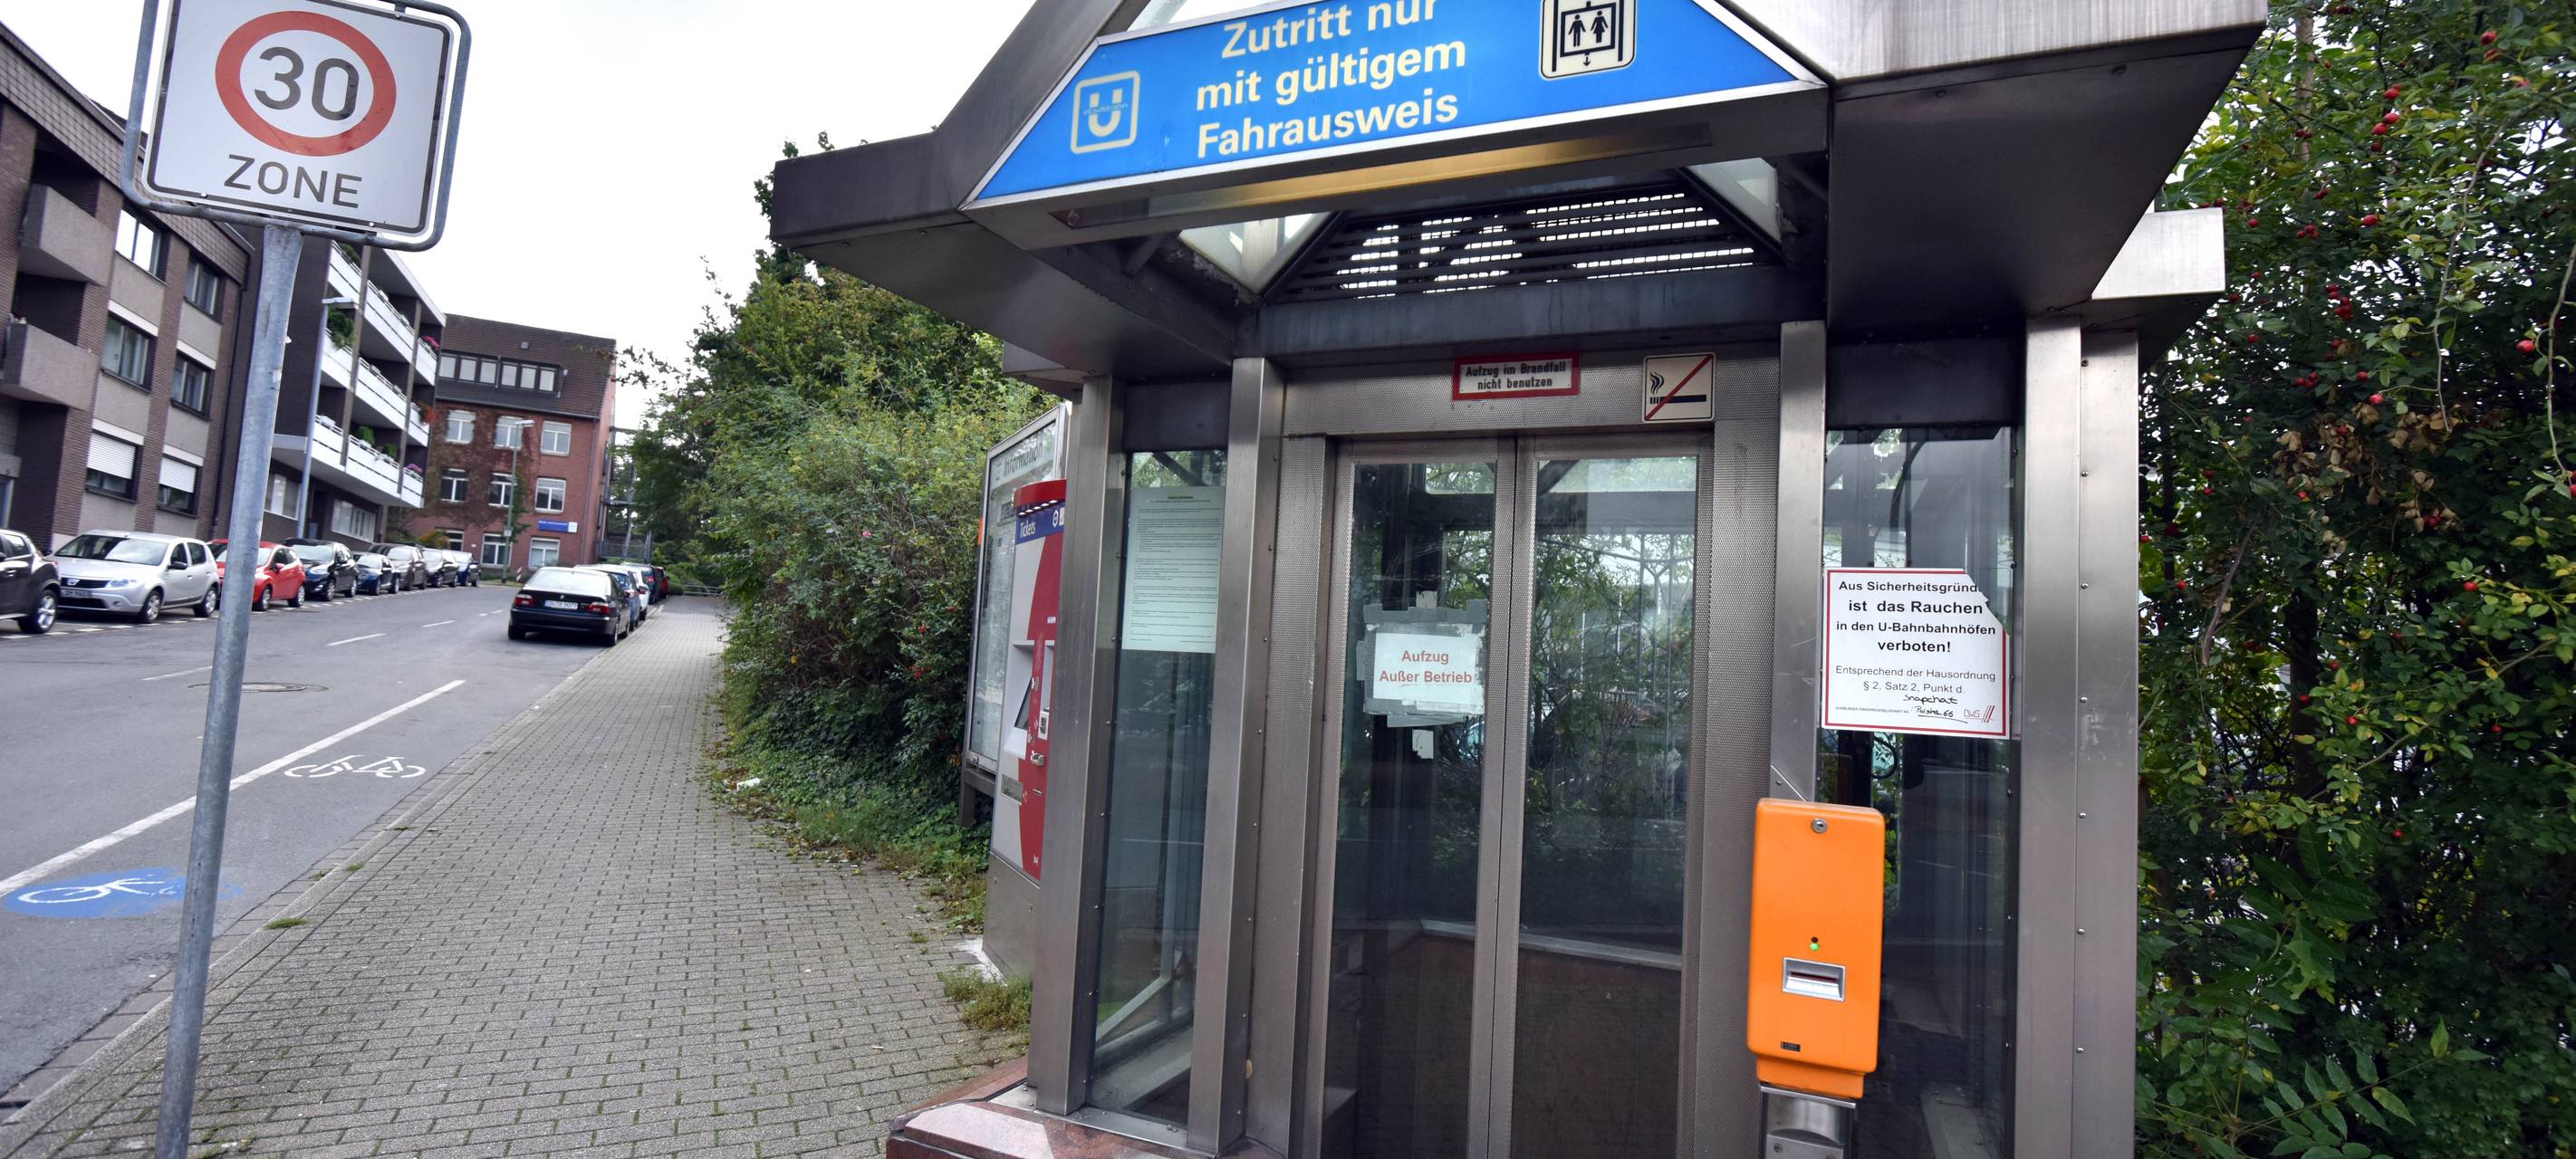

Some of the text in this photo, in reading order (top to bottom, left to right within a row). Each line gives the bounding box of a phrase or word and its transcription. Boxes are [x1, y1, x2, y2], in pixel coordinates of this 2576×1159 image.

[1221, 0, 1438, 59] Zutritt nur
[1196, 39, 1466, 111] mit gültigem
[254, 46, 360, 121] 30
[1197, 87, 1459, 159] Fahrausweis
[224, 153, 363, 209] ZONE
[1465, 360, 1567, 378] Aufzug im Brandfall
[1477, 377, 1553, 390] nicht benutzen
[1020, 520, 1037, 538] Tickets
[1839, 580, 1983, 595] Aus Sicherheitsgründ
[1849, 599, 1984, 615] ist das Rauchen
[1836, 620, 1996, 635] in den U-Bahnbahnhöfen
[1878, 640, 1951, 653] verboten!
[1401, 650, 1450, 665] Aufzug
[1379, 670, 1473, 684] Außer Betrieb
[1835, 665, 1996, 682] Entsprechend der Hausordnung
[1863, 680, 1966, 694] § 2, Satz 2, Punkt d.
